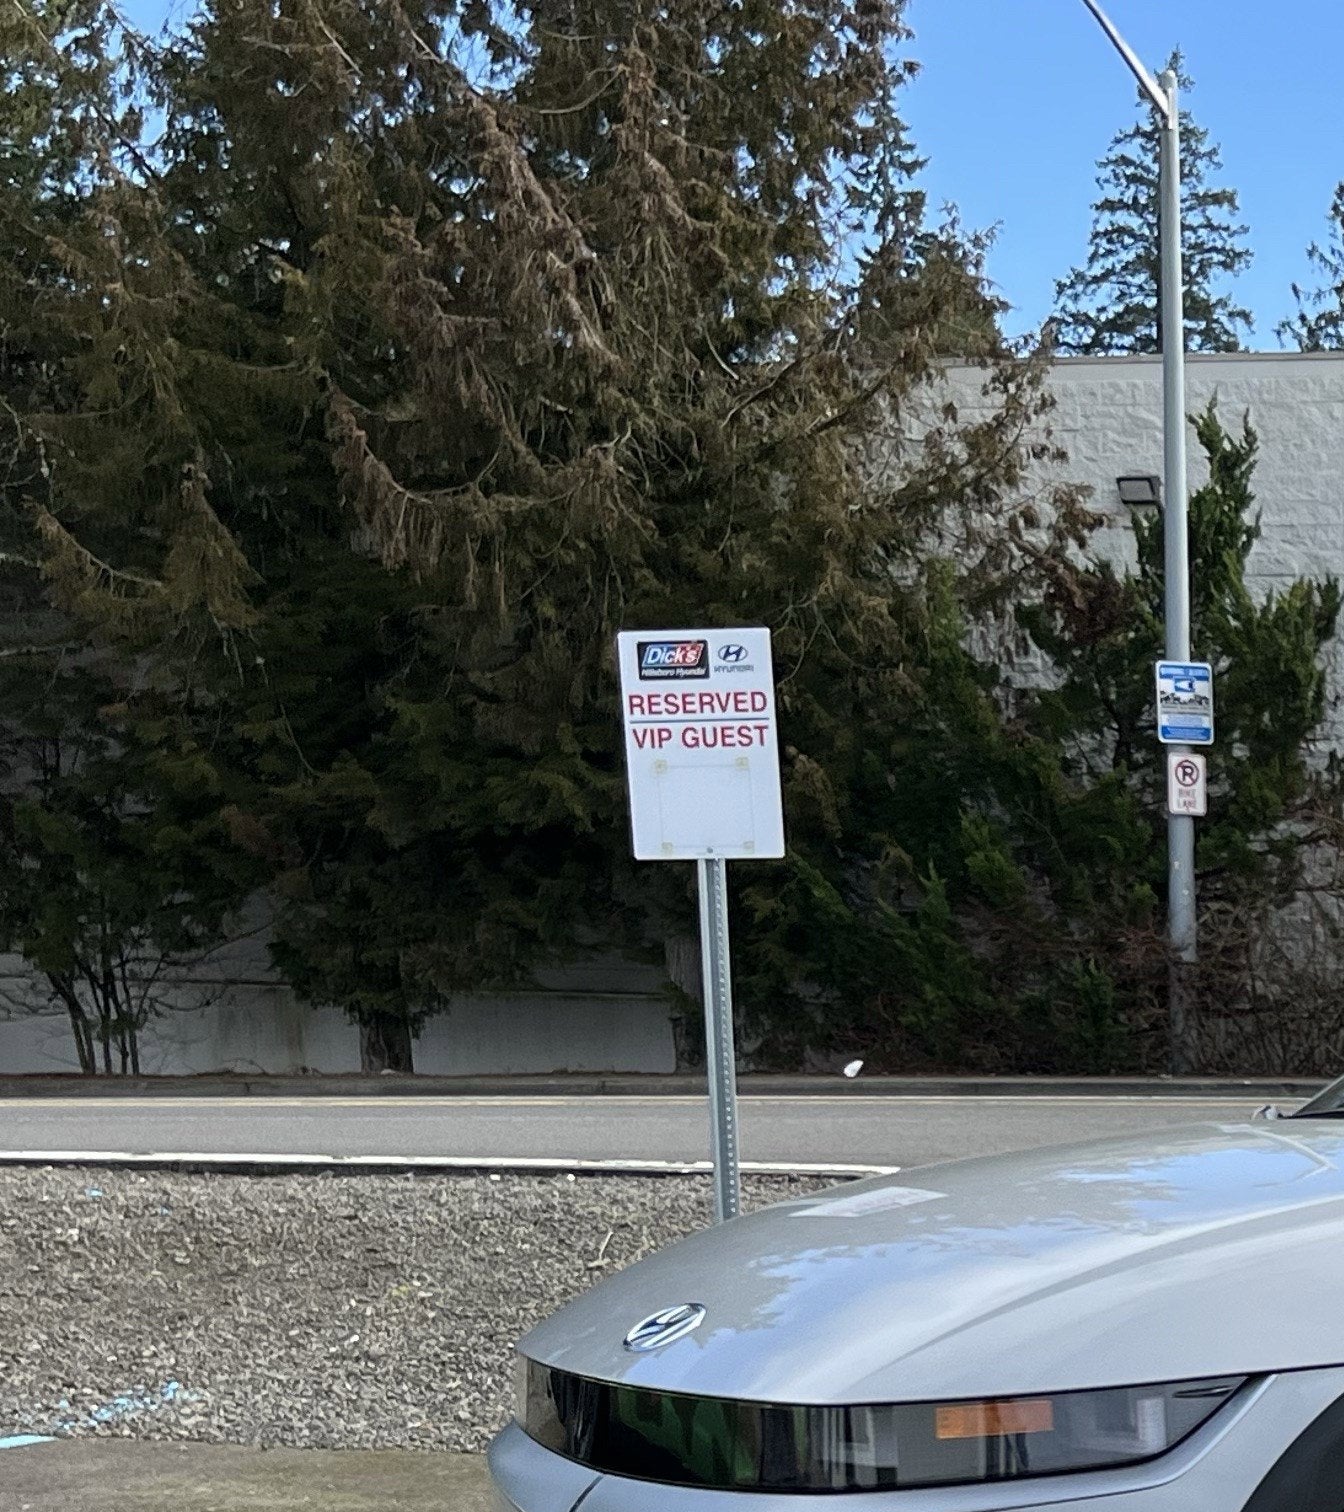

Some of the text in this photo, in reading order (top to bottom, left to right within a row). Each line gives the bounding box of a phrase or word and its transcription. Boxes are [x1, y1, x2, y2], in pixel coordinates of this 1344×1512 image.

[646, 645, 698, 664] Dick's
[628, 691, 768, 715] RESERVED
[632, 725, 769, 749] VIP GUEST
